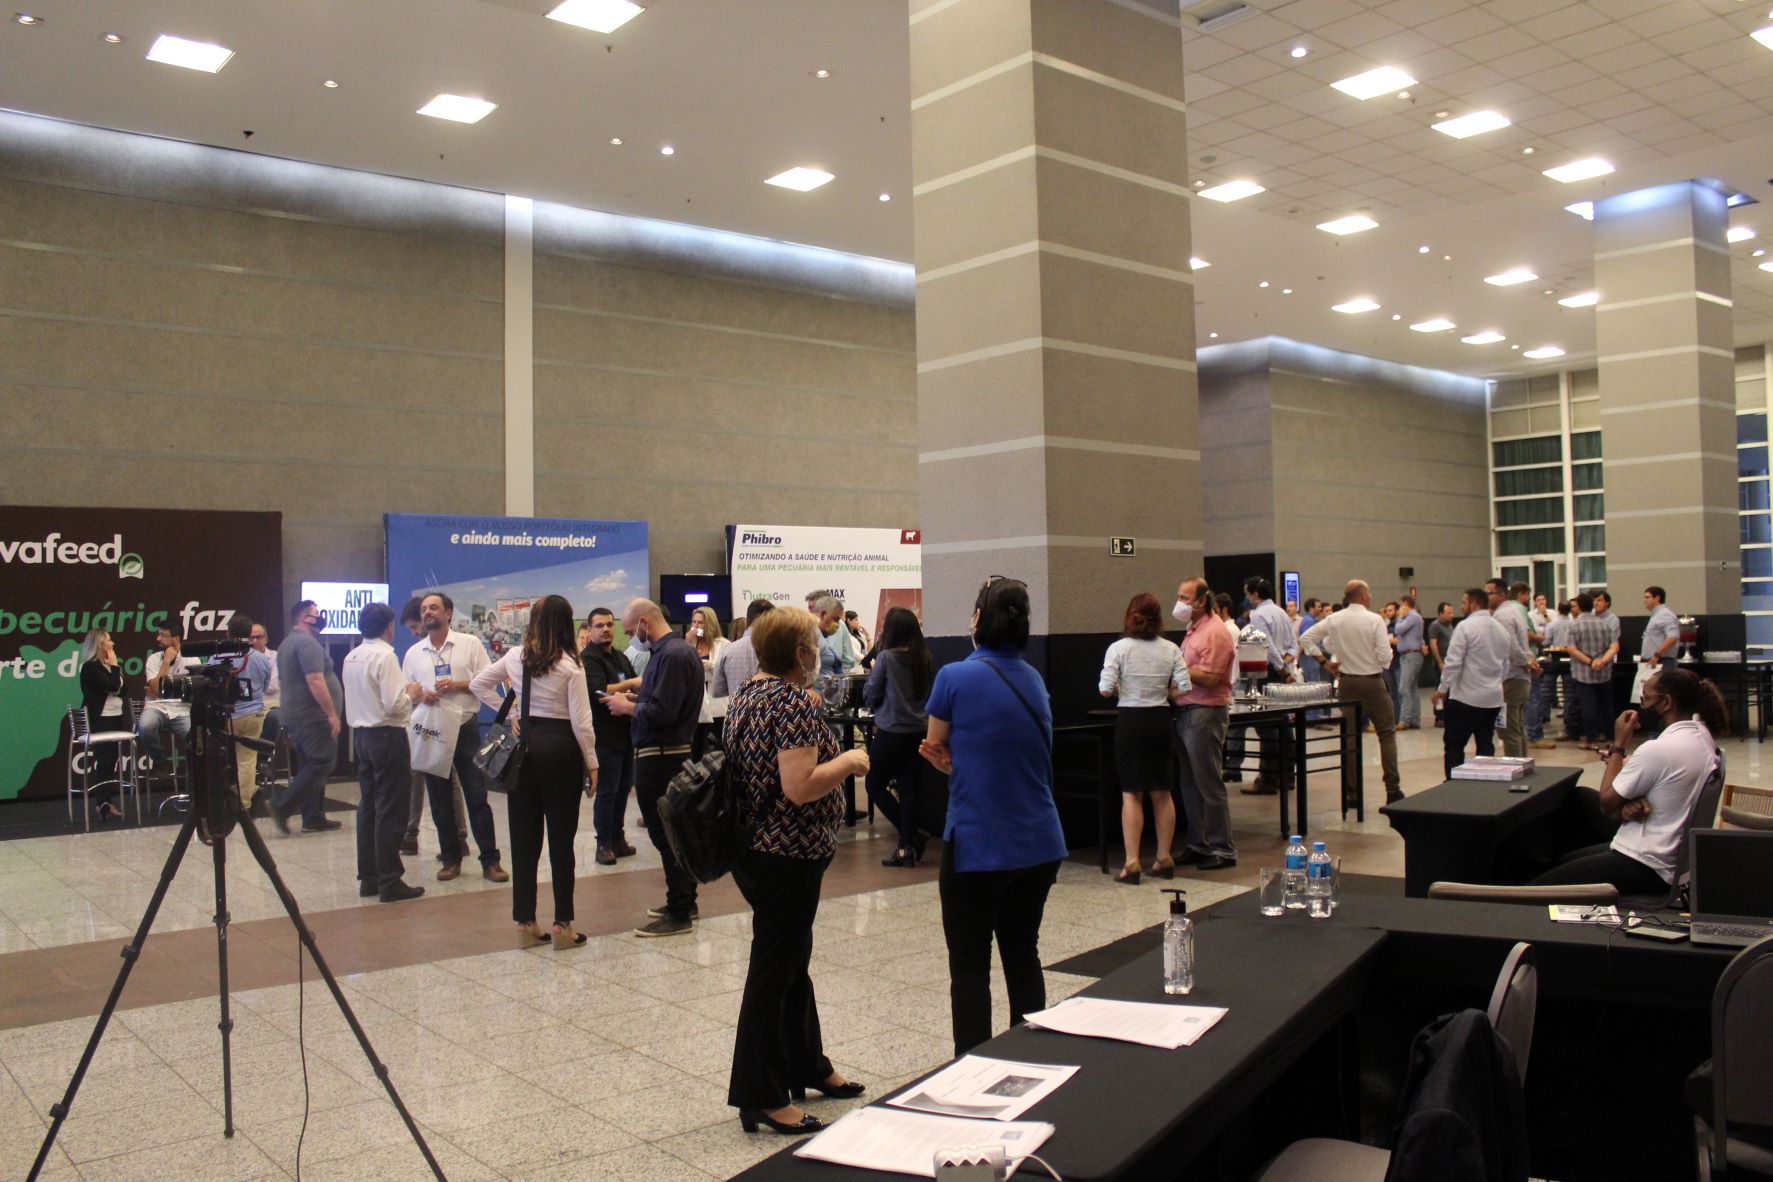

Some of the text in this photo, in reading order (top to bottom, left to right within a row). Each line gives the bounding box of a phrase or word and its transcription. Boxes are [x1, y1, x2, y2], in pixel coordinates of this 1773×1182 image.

[450, 530, 596, 549] e ainda mais completo!
[742, 533, 782, 544] Phibro
[0, 532, 122, 564] vafeed
[739, 553, 786, 561] OTIMIZANDO
[788, 553, 793, 561] A
[795, 552, 818, 561] SAÚDE
[827, 552, 862, 562] NUTRIÇÃO
[737, 563, 757, 571] PARA
[759, 563, 776, 571] UMA
[778, 562, 814, 571] PECUÁRIA
[816, 564, 833, 572] MAIS
[835, 562, 868, 572] RENTÁVEL
[871, 564, 876, 572] E
[345, 590, 373, 608] ANTI
[180, 601, 236, 640] faz
